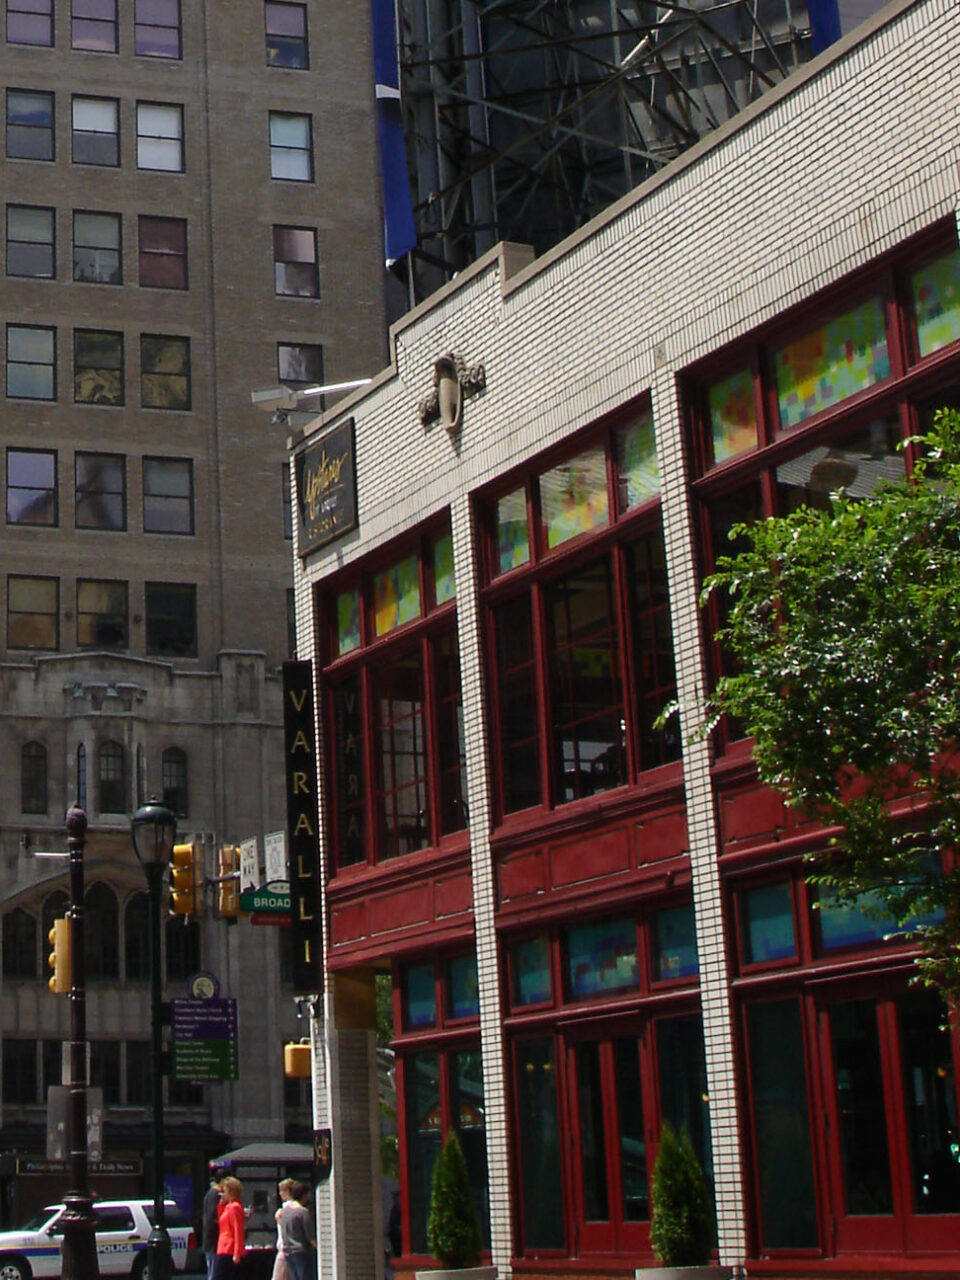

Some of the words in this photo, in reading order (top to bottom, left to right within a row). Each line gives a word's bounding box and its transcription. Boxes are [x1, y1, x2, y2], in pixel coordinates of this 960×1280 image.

[290, 689, 314, 963] VARALLI
[253, 897, 291, 908] BROAD
[96, 1244, 134, 1254] POLICE
